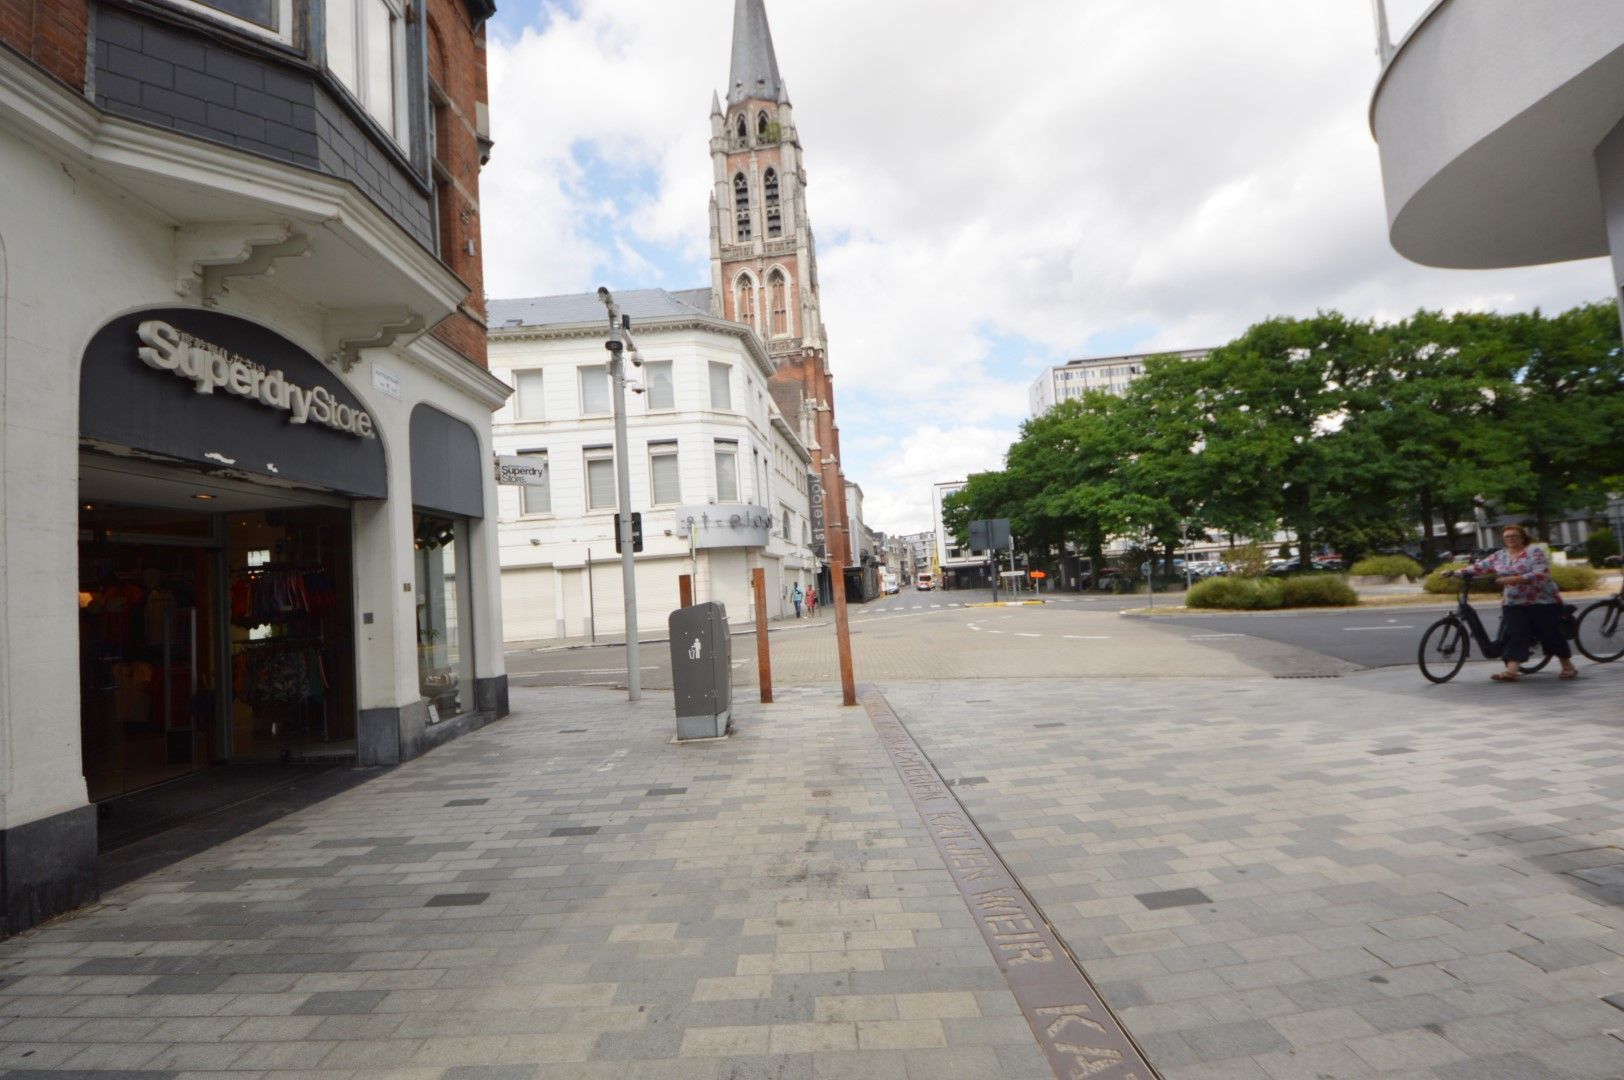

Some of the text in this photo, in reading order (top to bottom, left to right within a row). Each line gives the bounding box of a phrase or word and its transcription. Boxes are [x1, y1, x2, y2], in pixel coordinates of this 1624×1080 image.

[501, 465, 543, 478] Superdry
[926, 811, 1001, 882] KATJEN
[972, 887, 1055, 966] WEIR
[1034, 1004, 1139, 1080] KA
